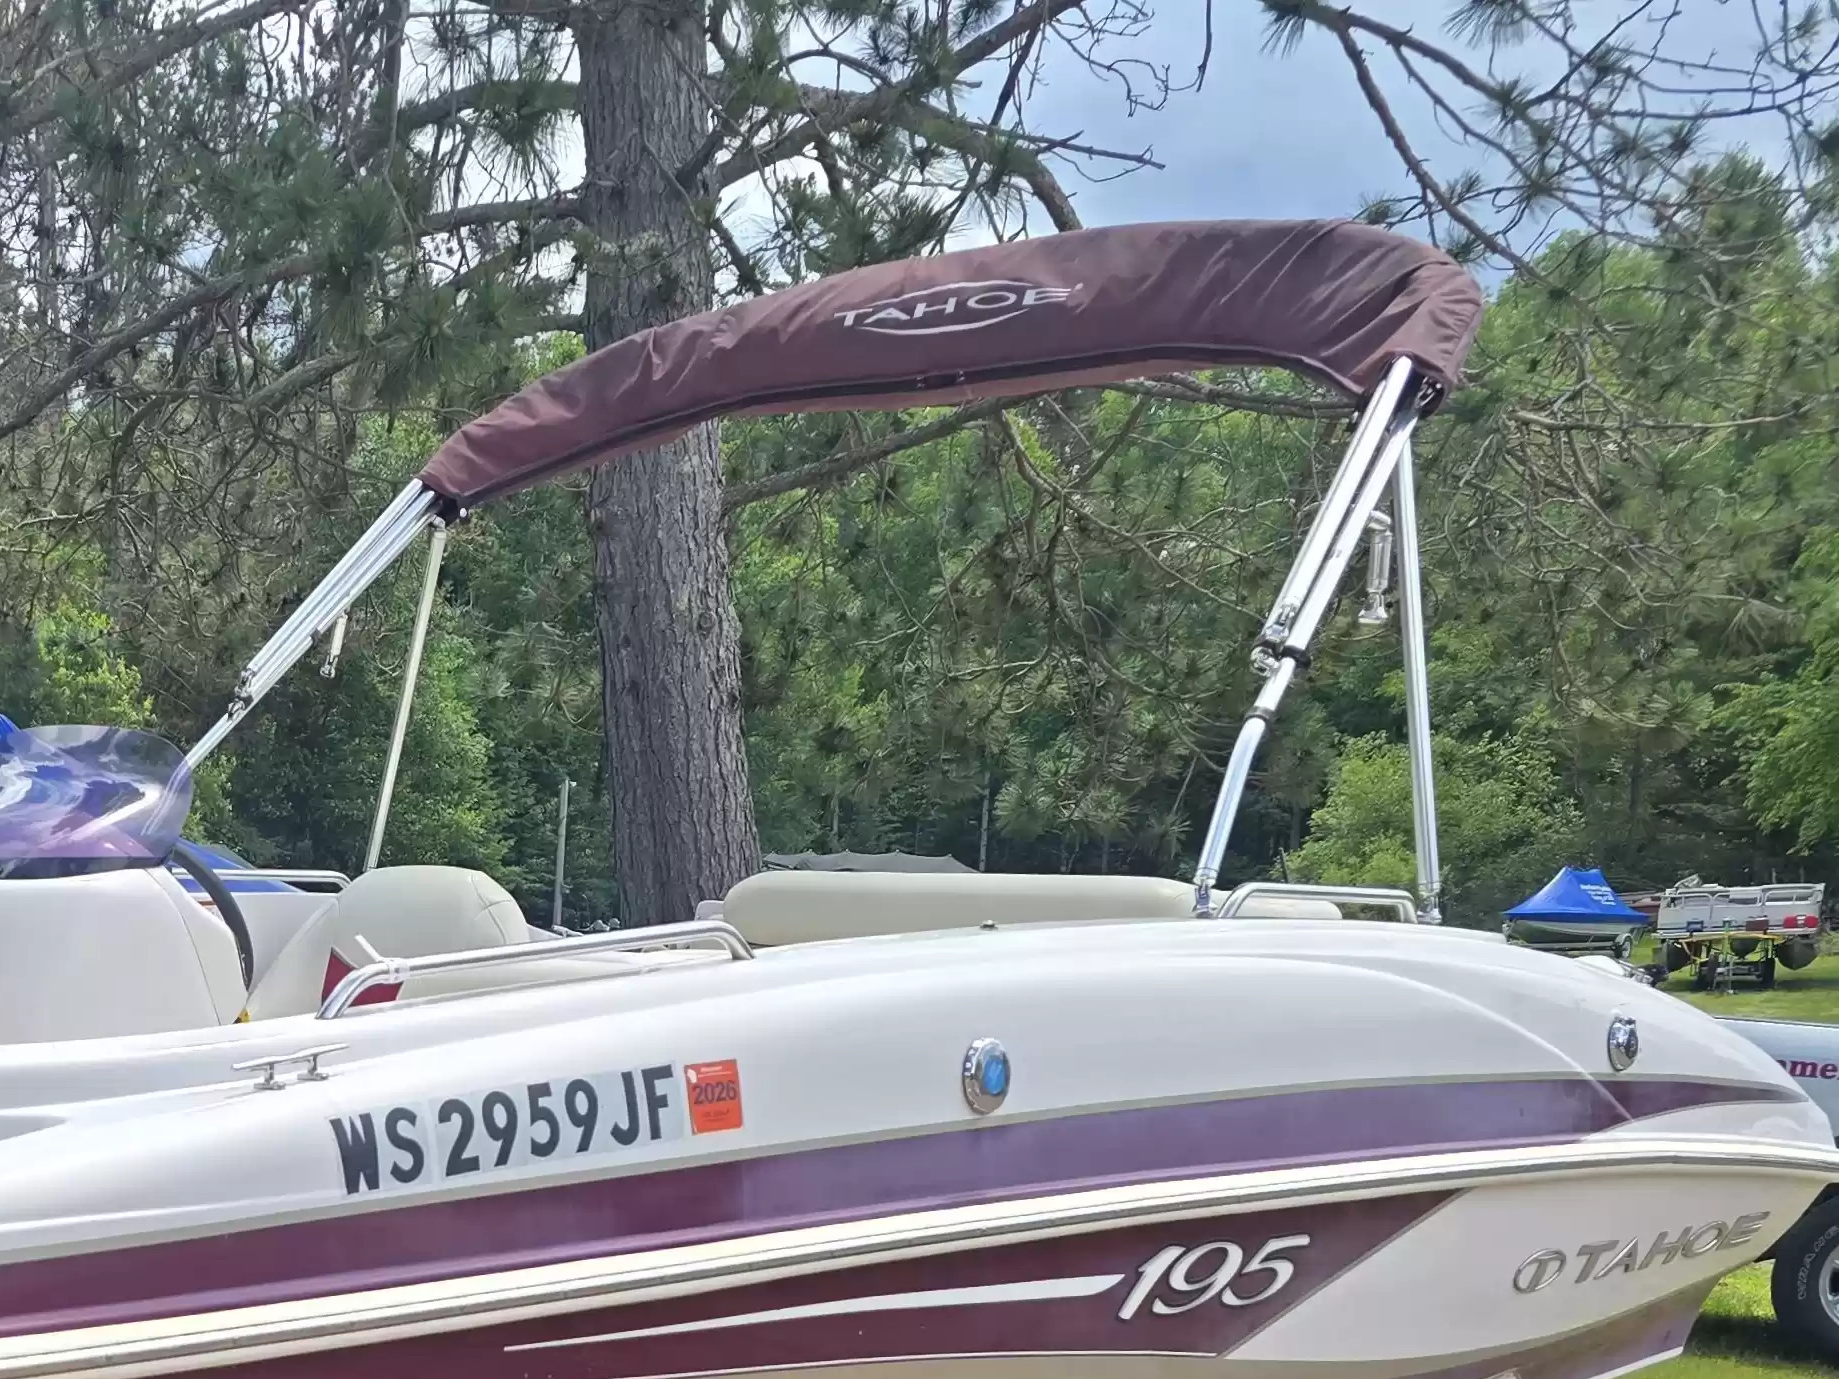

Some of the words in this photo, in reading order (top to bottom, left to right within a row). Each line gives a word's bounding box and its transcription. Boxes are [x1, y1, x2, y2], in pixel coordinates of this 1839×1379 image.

[834, 283, 1083, 328] TAHOE
[691, 1079, 738, 1105] 2026
[330, 1107, 425, 1194] WS
[437, 1078, 599, 1177] 2959
[609, 1064, 675, 1146] JF
[1116, 1232, 1311, 1321] 195
[1575, 1211, 1770, 1284] TAHOE
